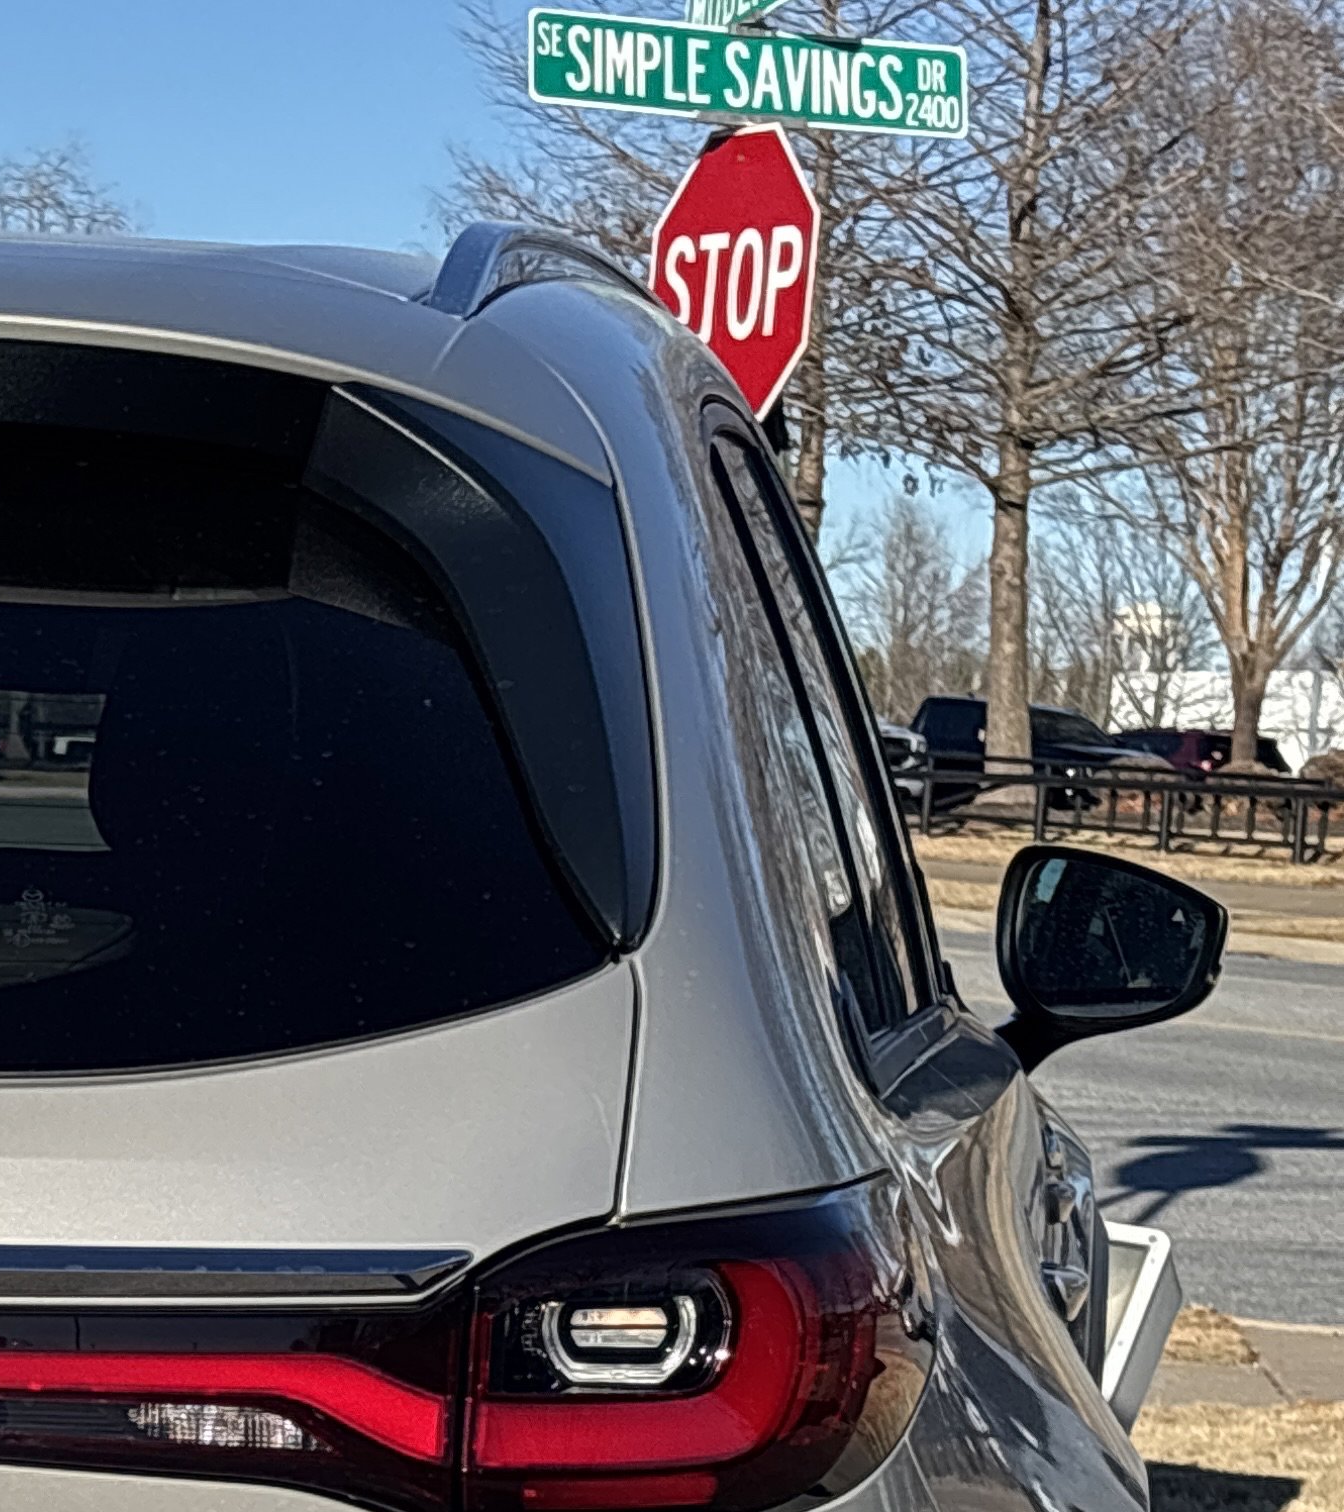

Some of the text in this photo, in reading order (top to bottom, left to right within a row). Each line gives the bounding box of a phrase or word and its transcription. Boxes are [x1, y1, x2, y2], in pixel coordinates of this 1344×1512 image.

[537, 20, 947, 119] SE SIMPLE SAVINGS DR
[906, 93, 959, 128] 2400
[665, 225, 802, 341] STOP
